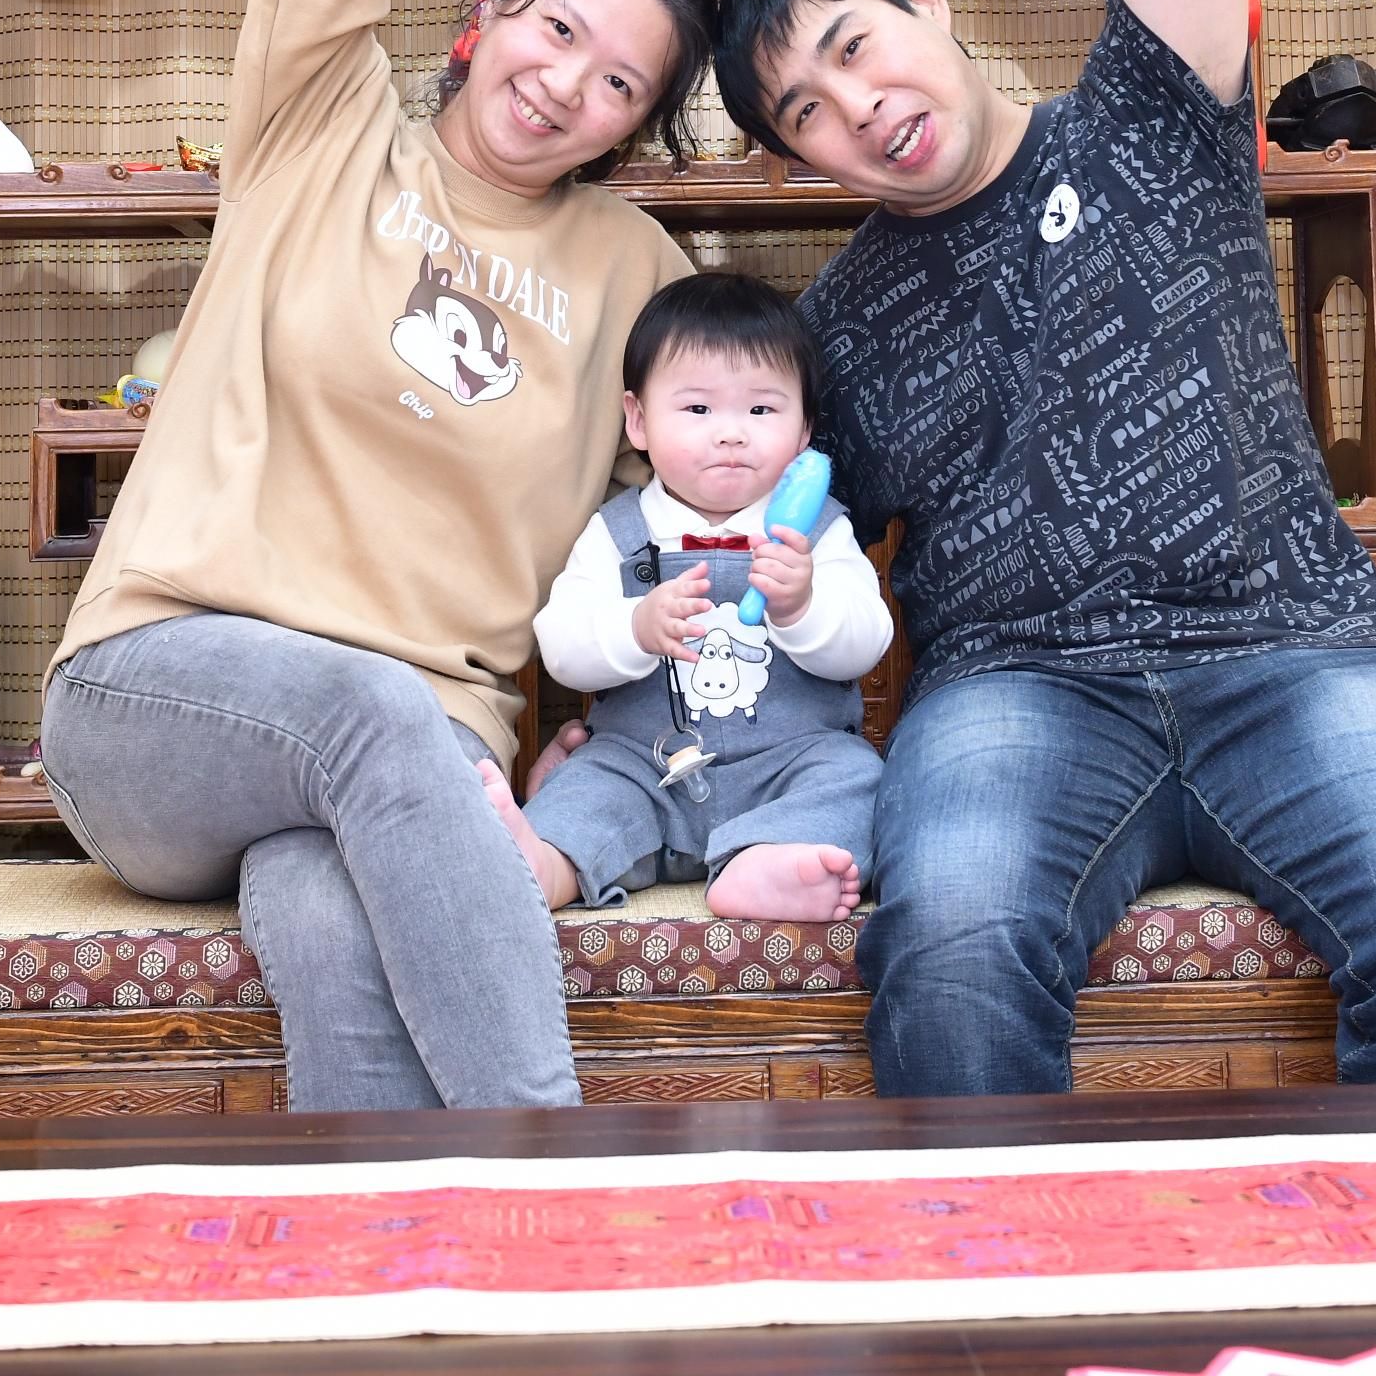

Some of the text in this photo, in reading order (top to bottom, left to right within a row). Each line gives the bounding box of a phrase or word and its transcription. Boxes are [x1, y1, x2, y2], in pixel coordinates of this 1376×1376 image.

[1108, 158, 1152, 205] PLAYBOY
[1144, 221, 1179, 264] PLAYBOY
[485, 253, 570, 345] DALE
[863, 270, 929, 322] PLAYBOY
[992, 278, 1023, 332] PLAYBOY
[1154, 268, 1208, 310] PLAYBOY
[890, 301, 937, 338] PLAYBOY
[1058, 315, 1126, 368] PLAYBOY
[1086, 347, 1138, 387] PLAYBOY
[398, 390, 434, 419] Chip
[1111, 367, 1212, 449] PLAYBOY
[888, 406, 944, 457] PLAYBOY
[1163, 423, 1214, 468] PLAYBOY
[1042, 450, 1076, 506] PLAYBOY
[1096, 459, 1164, 512] PLAYBOY
[1136, 445, 1222, 514] PLAYBOY
[942, 485, 1032, 560] PLAYBOY
[1062, 523, 1098, 569] PLAYBOY
[1149, 493, 1223, 552] PLAYBOY
[1183, 523, 1235, 568] PLAYBOY
[985, 543, 1029, 586] PLAYBOY
[1283, 532, 1314, 584] PLAYBOY
[937, 576, 984, 616] PLAYBOY
[1000, 614, 1047, 640] PLAYBOY
